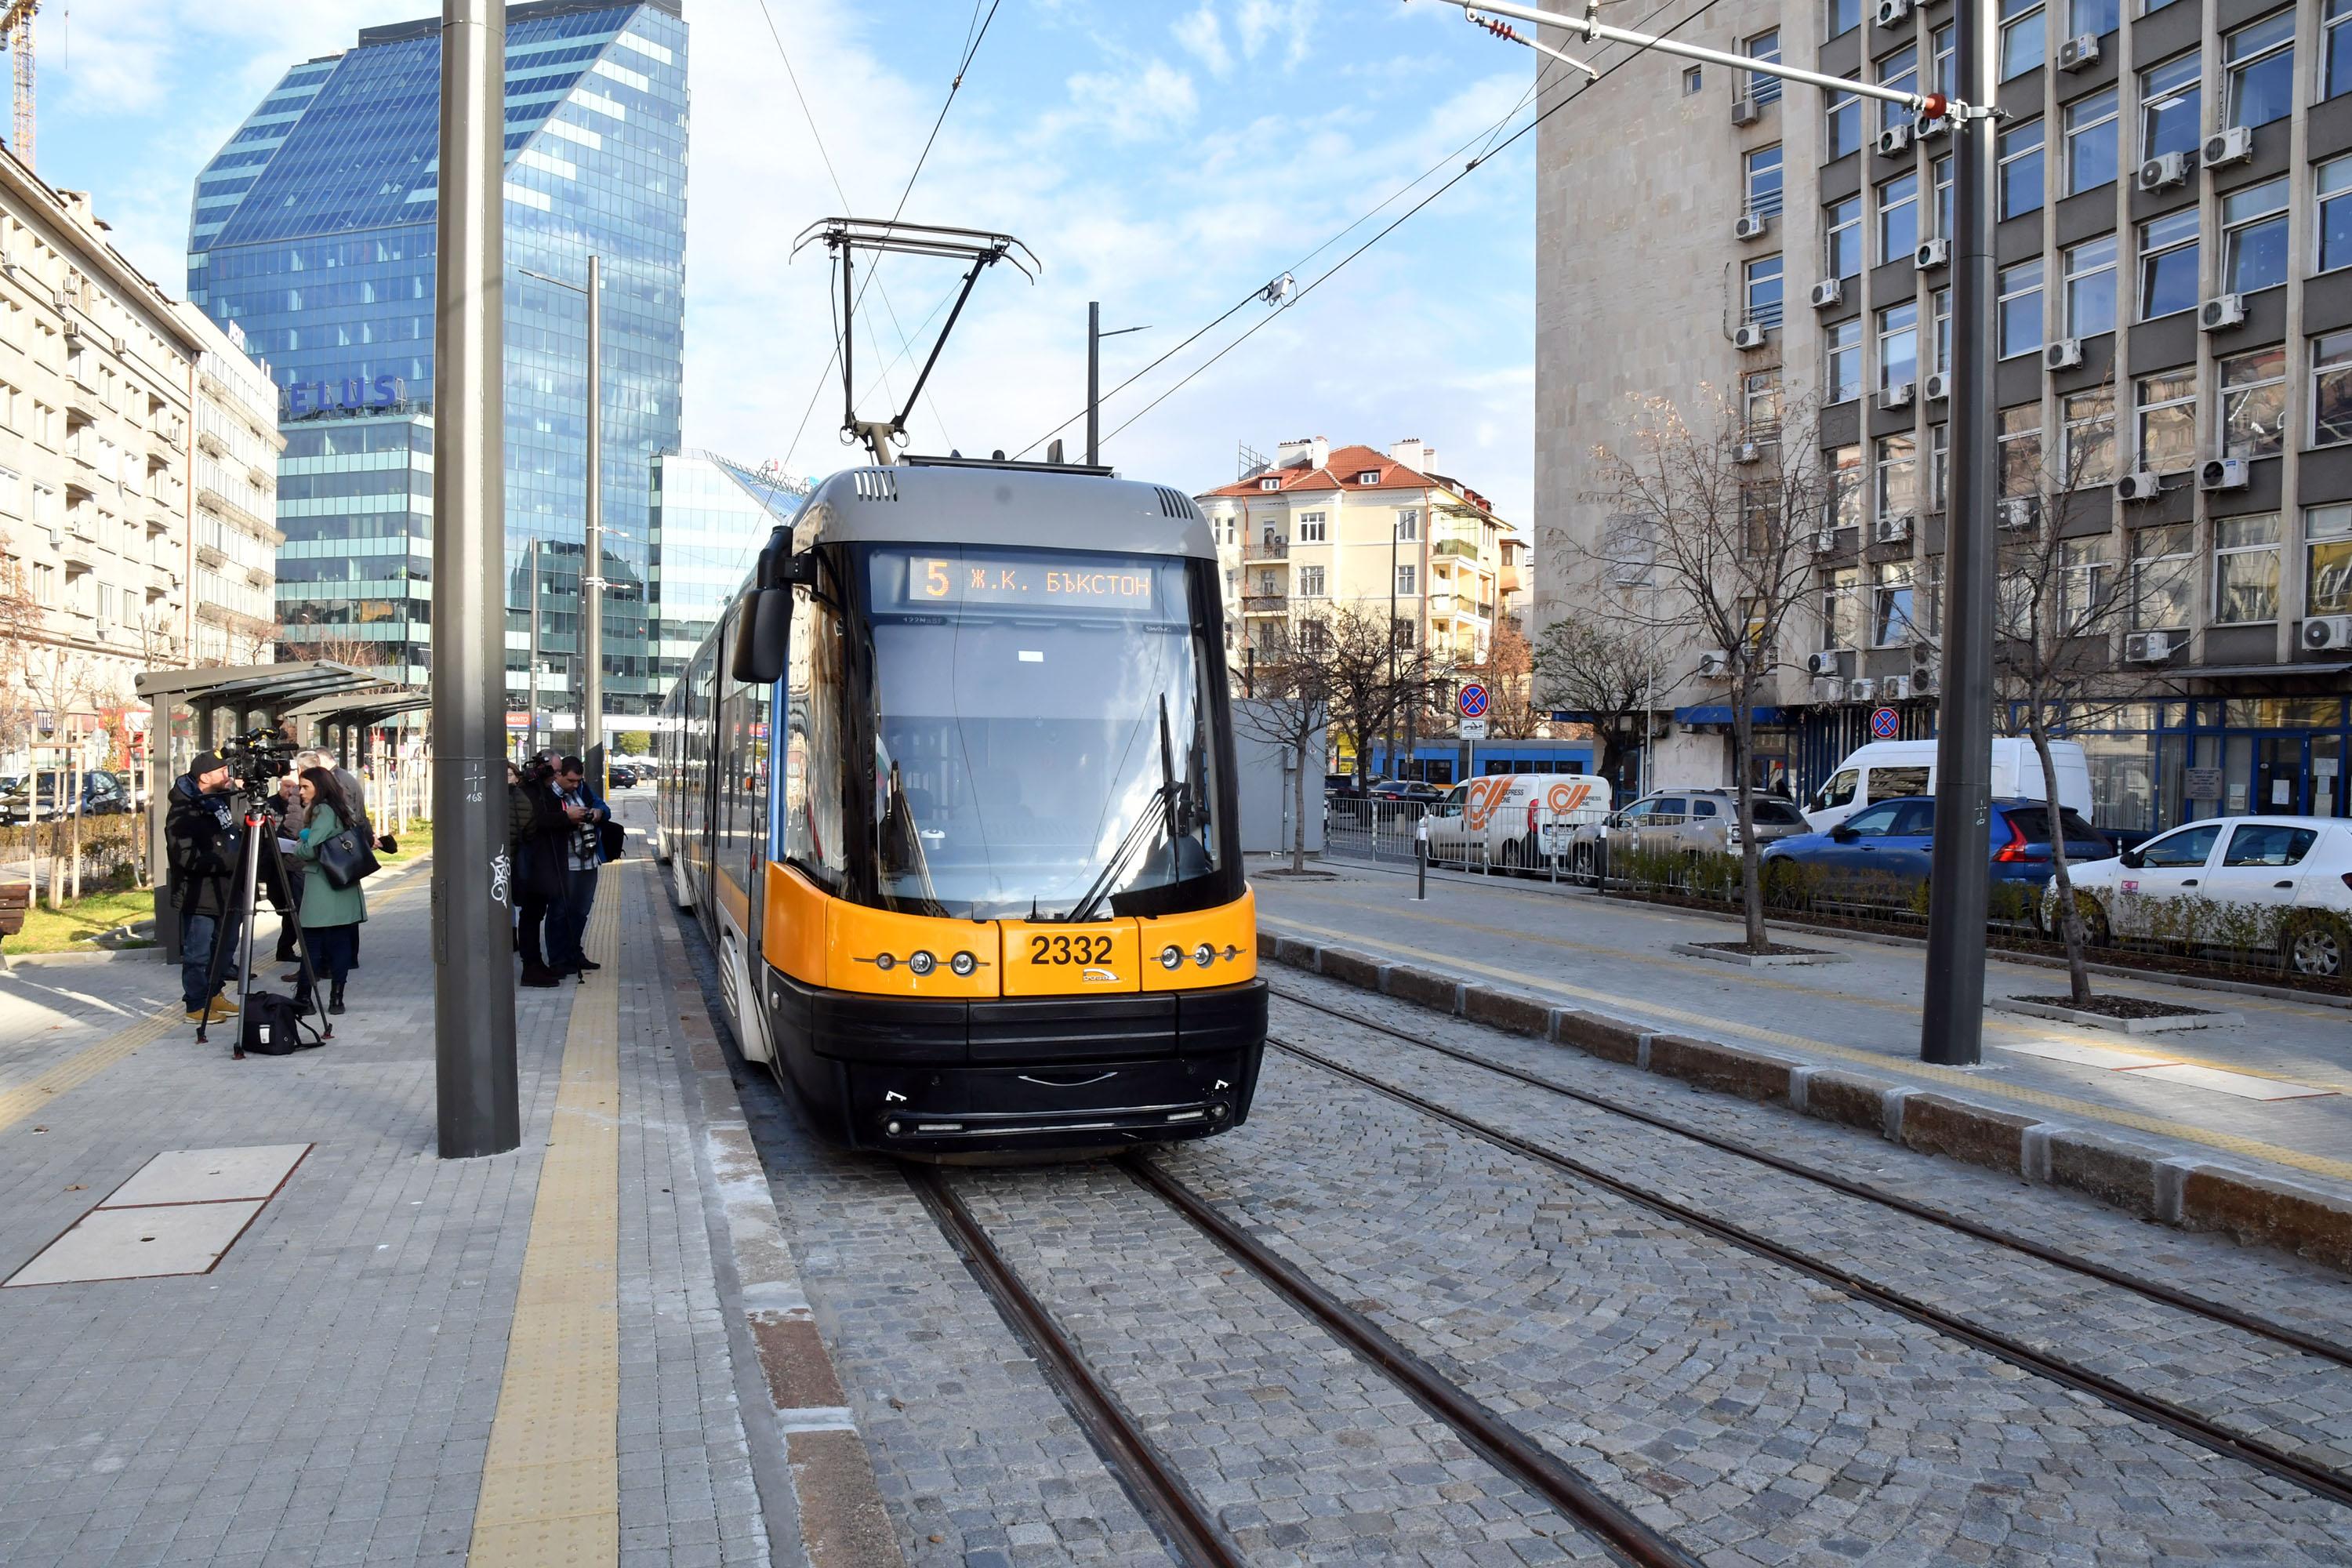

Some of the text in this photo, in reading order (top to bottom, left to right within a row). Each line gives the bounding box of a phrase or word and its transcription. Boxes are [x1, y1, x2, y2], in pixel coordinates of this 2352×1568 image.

[278, 376, 396, 412] ELUS
[926, 561, 1150, 597] 5 Ж.К. БЪКСТОН
[1030, 935, 1113, 965] 2332
